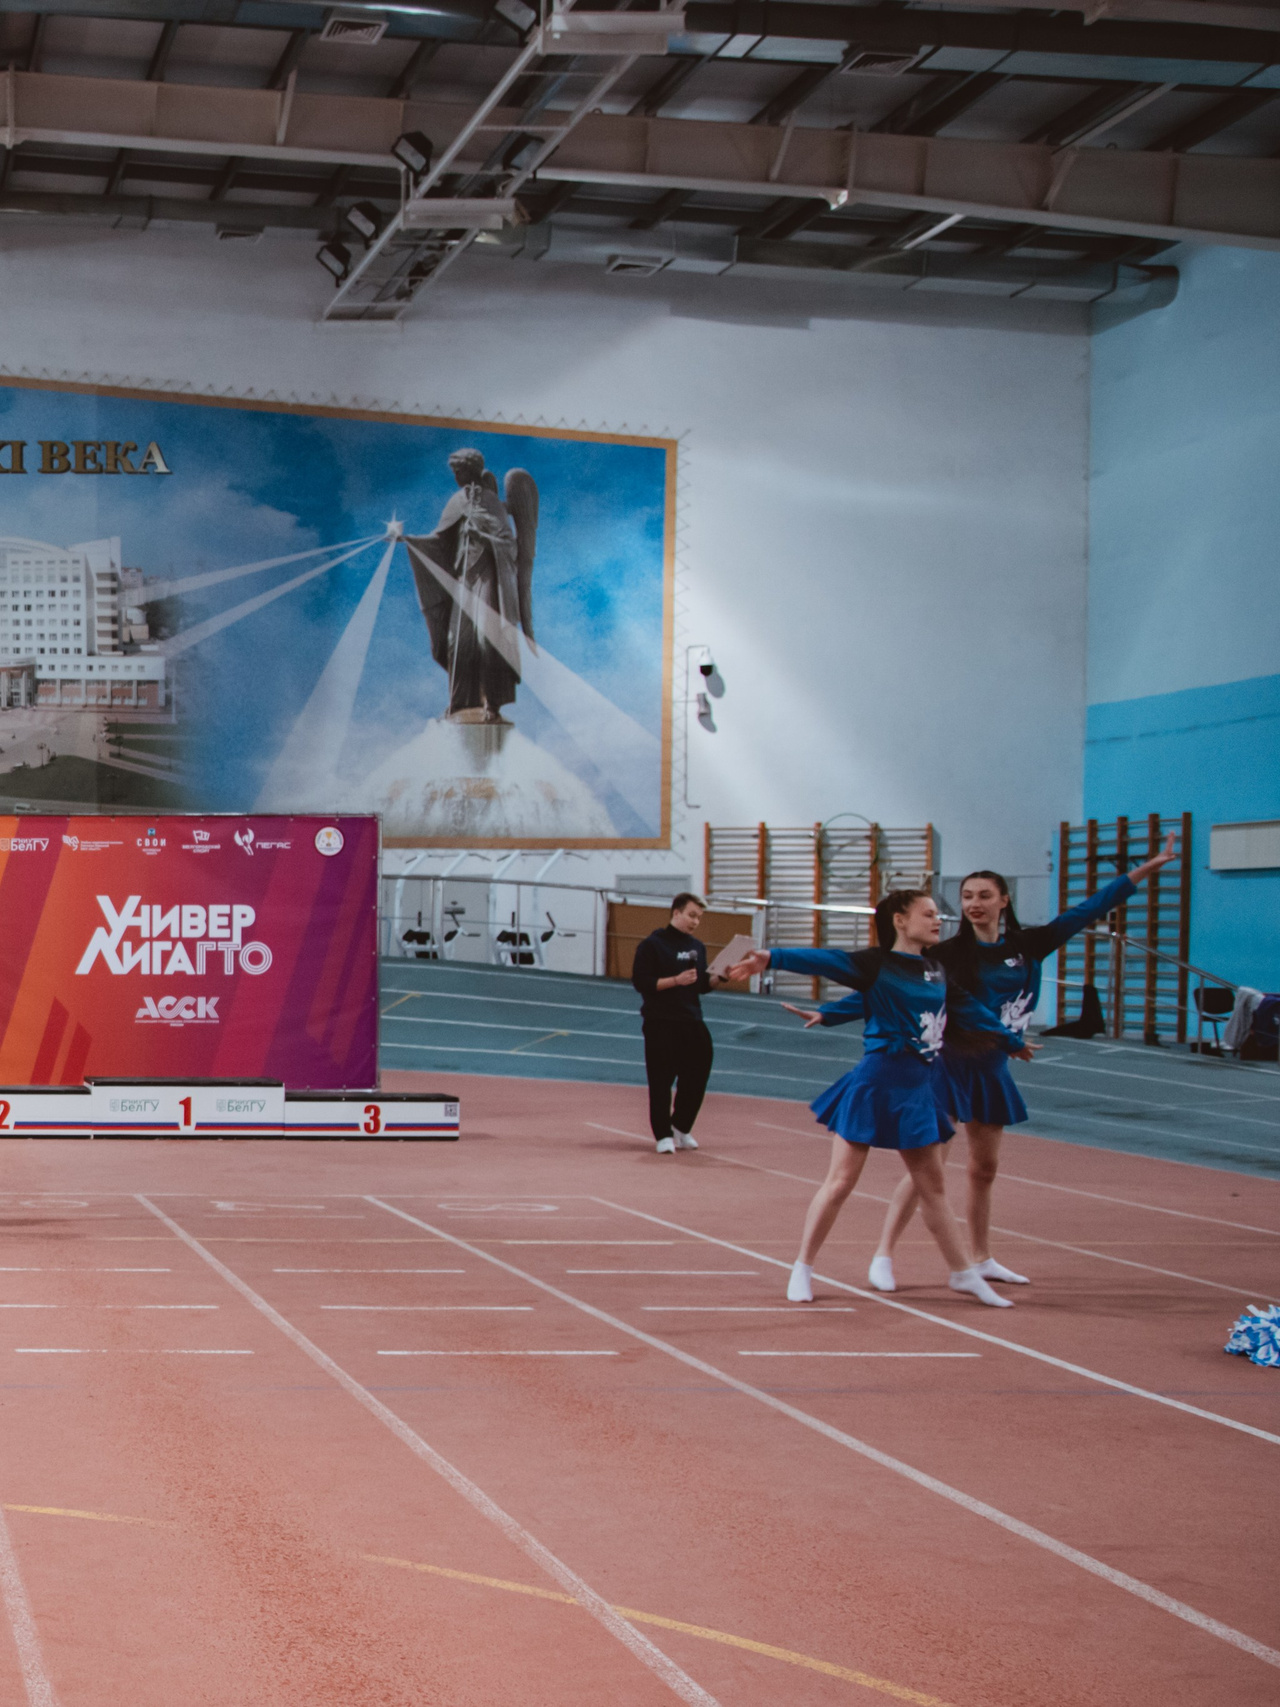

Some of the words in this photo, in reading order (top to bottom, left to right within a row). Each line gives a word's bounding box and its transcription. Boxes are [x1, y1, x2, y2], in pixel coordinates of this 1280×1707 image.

[37, 440, 173, 475] ВЕКА
[10, 838, 49, 851] БелГУ
[136, 838, 167, 847] СВОИ
[135, 995, 220, 1019] АССК
[120, 1100, 160, 1112] БелГУ
[179, 1096, 192, 1126] 1
[227, 1100, 266, 1112] БелГУ
[364, 1104, 381, 1134] 3
